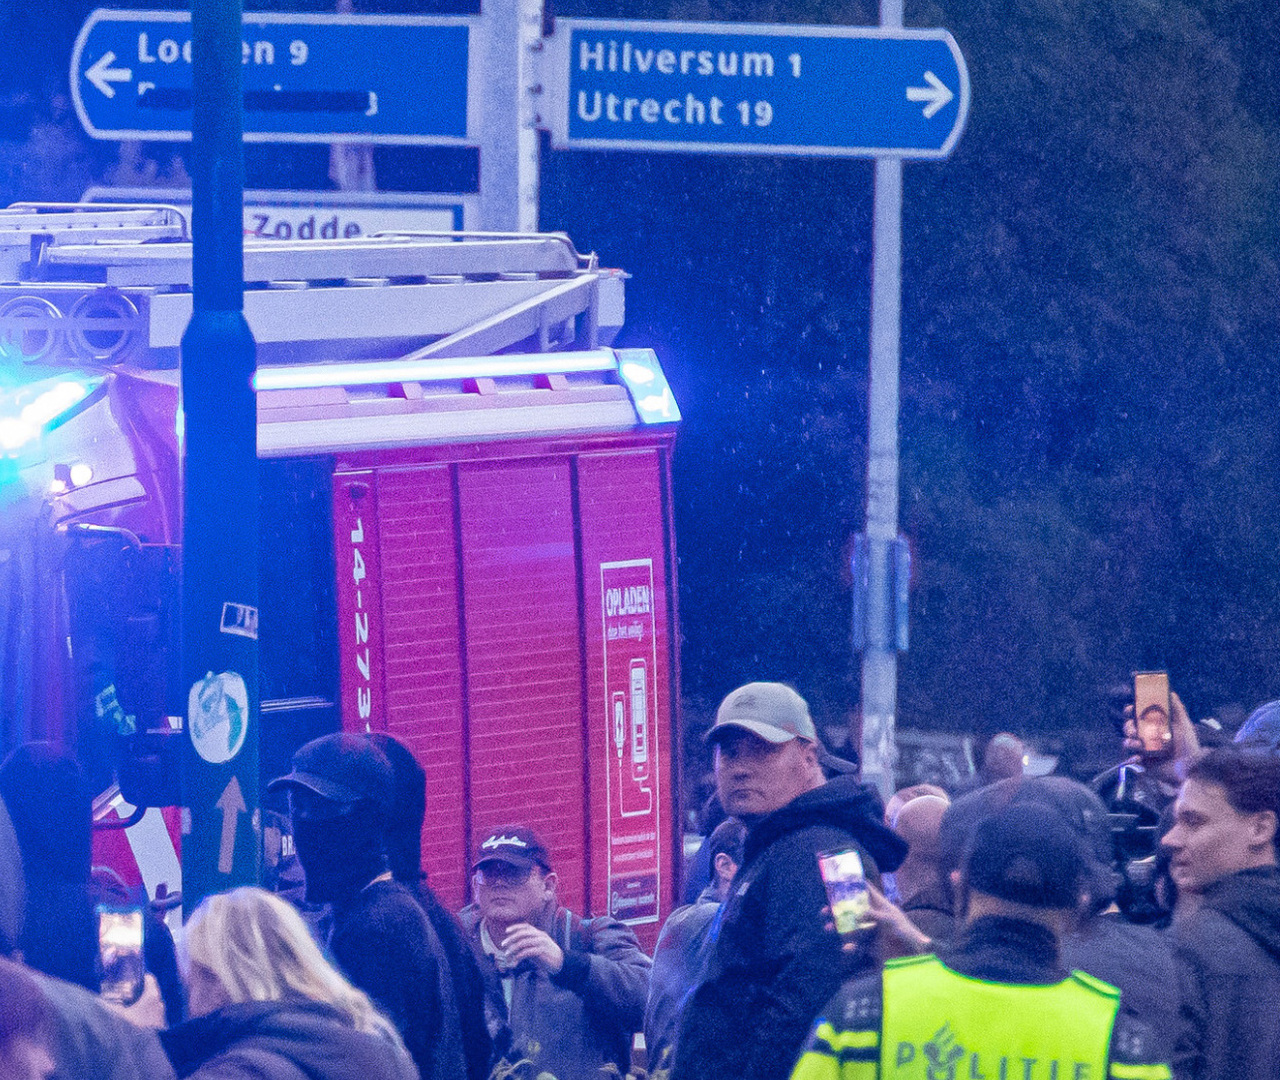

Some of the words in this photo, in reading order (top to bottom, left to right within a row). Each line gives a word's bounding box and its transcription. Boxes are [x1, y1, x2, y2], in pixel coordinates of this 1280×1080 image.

[289, 39, 309, 66] 9
[579, 40, 775, 77] Hilversum
[789, 52, 802, 78] 1
[577, 90, 723, 126] Utrecht
[737, 100, 774, 127] 19
[253, 214, 361, 241] Zodde
[606, 585, 650, 617] OPLADEN
